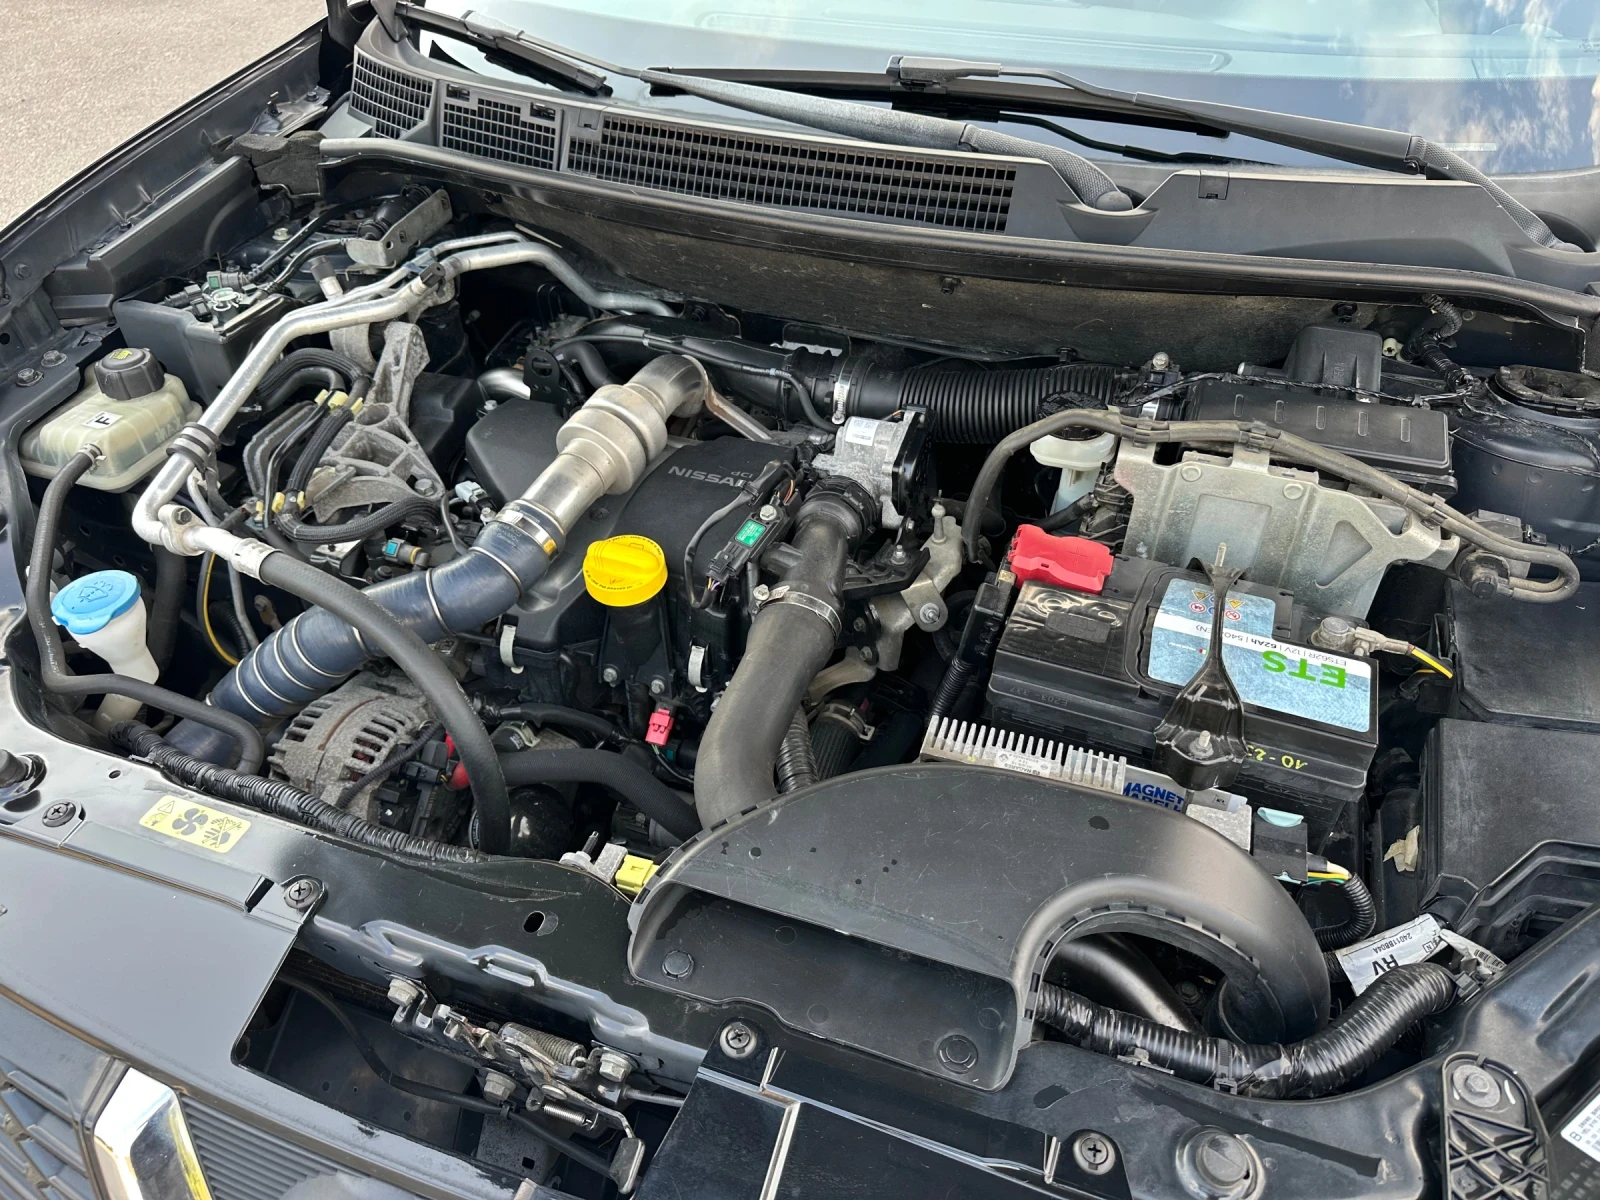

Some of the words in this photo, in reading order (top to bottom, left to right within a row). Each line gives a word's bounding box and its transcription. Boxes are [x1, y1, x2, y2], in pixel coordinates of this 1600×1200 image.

[95, 416, 110, 425] F
[1251, 638, 1277, 649] 62Ah
[1284, 647, 1301, 656] 12V
[1308, 652, 1347, 667] ETS62R
[1262, 650, 1346, 689] ETS
[1371, 954, 1399, 976] RV
